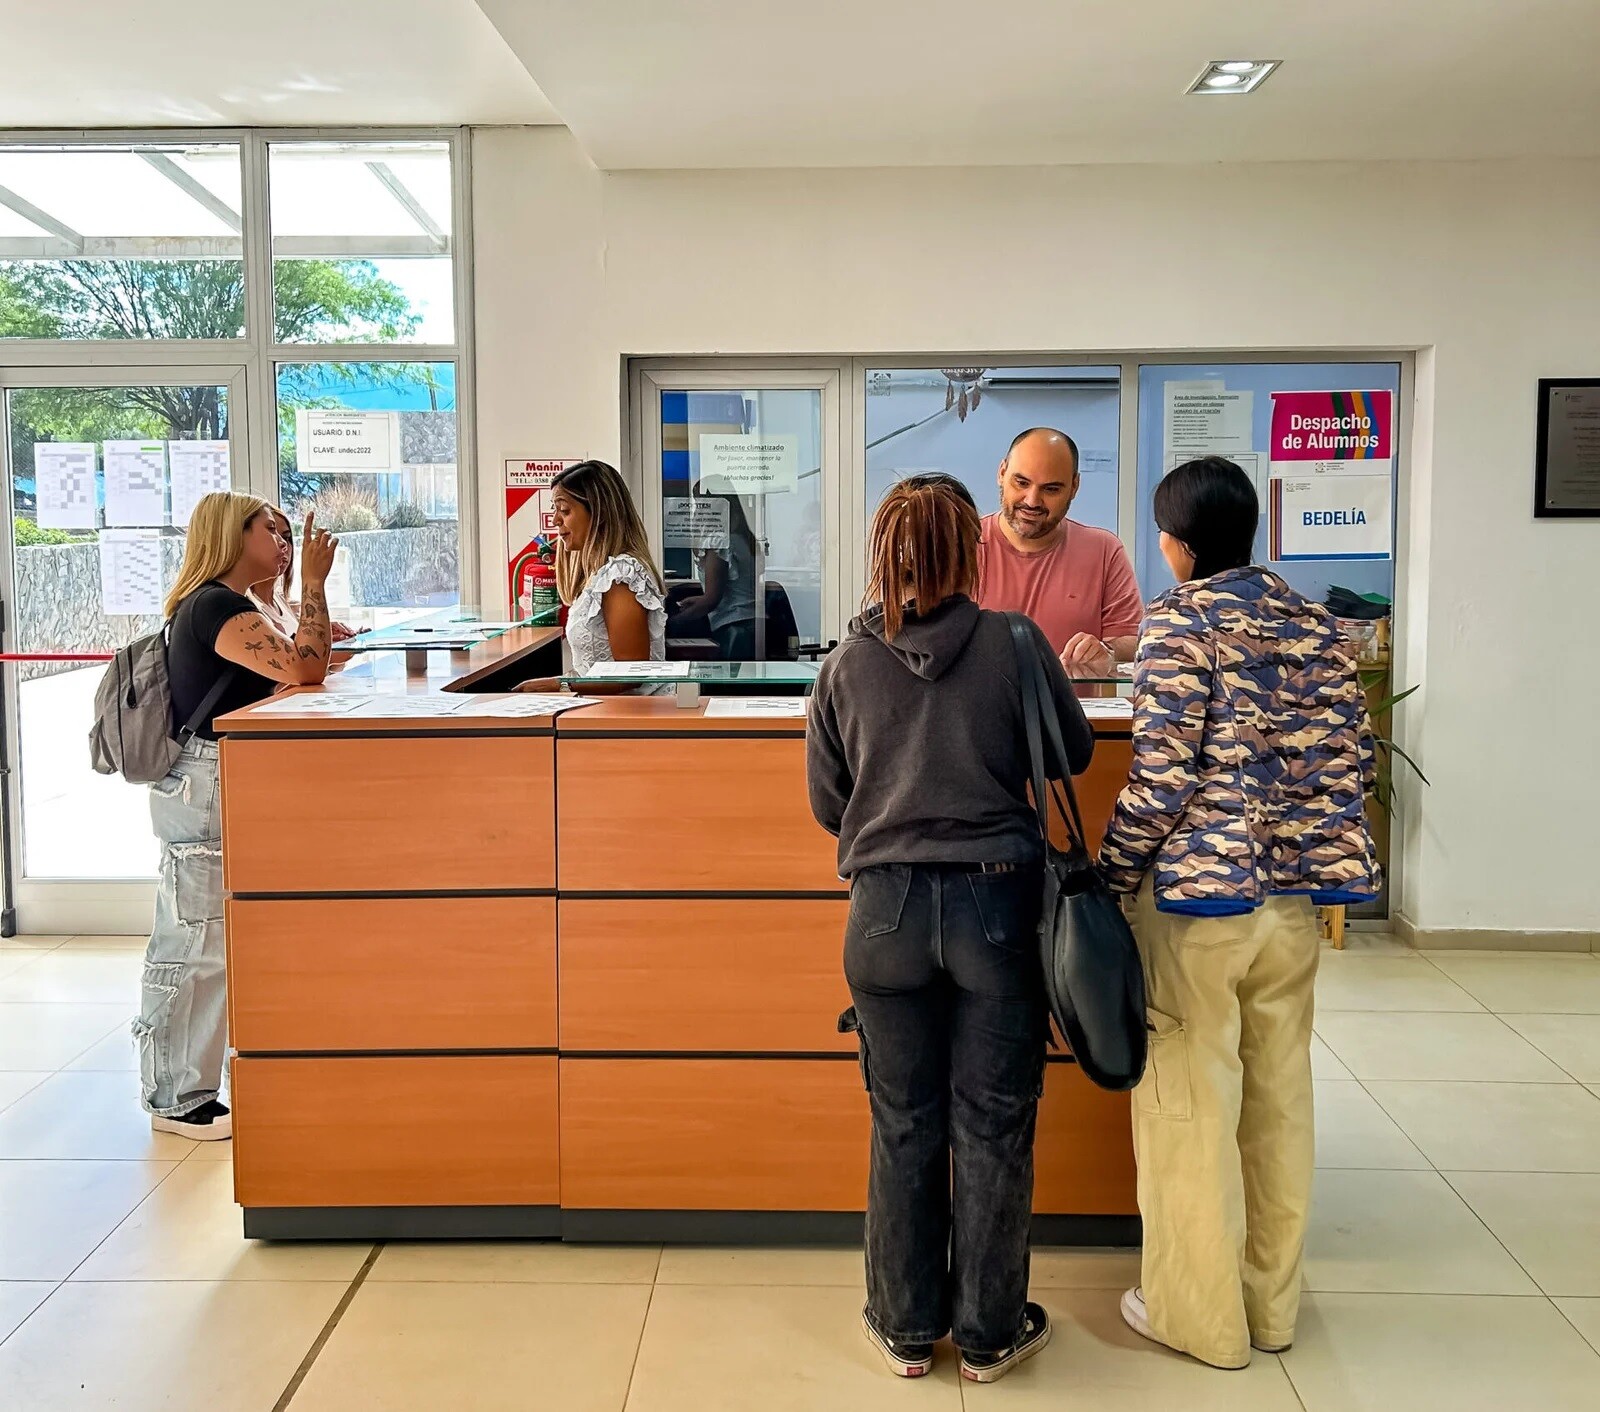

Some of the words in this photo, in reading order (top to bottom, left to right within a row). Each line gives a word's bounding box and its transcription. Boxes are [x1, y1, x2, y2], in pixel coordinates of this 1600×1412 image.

[1290, 414, 1371, 432] Despacho
[1282, 434, 1303, 449] de
[1307, 433, 1379, 449] Alumnos
[526, 462, 563, 471] Manini
[1303, 507, 1367, 526] BEDELÍA
